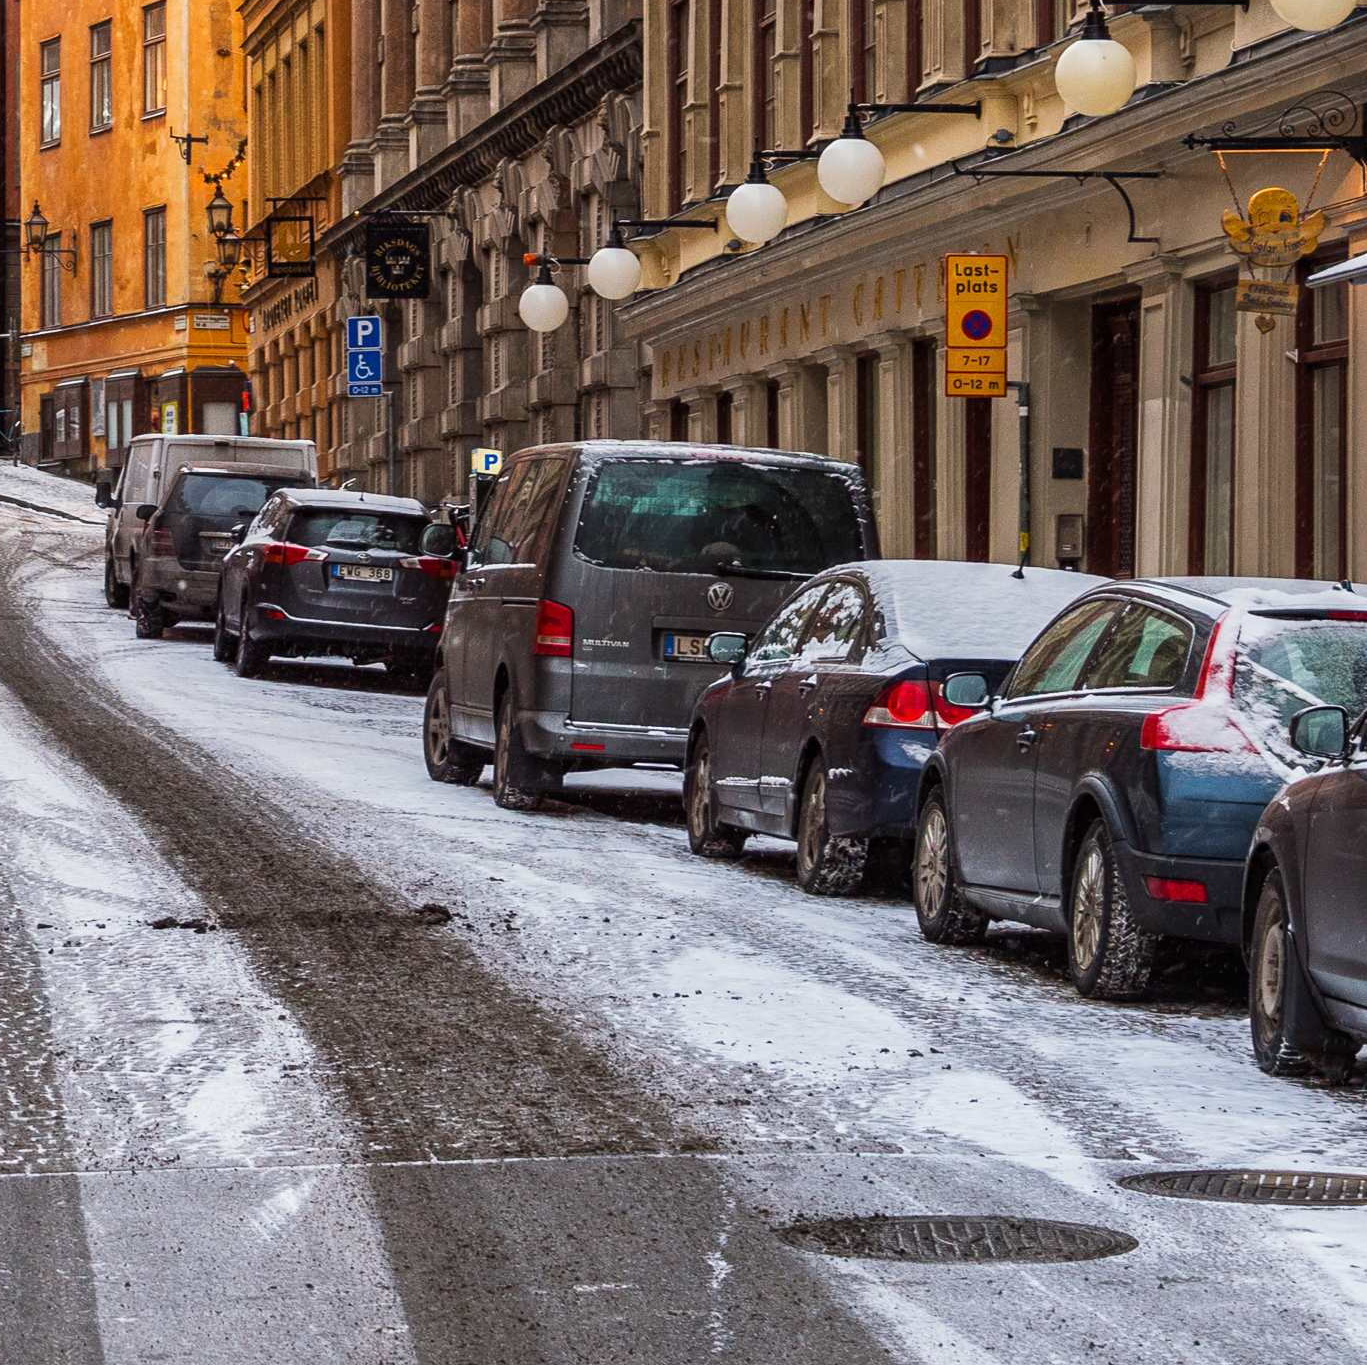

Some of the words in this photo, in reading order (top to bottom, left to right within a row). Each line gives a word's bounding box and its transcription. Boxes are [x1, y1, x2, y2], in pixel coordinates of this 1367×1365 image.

[374, 239, 422, 257] RIKSDAGS
[272, 265, 312, 274] apoteket
[955, 263, 999, 277] Last-
[371, 265, 424, 291] BIBLIOTEKET
[956, 280, 998, 295] plats
[661, 294, 832, 387] RESTAURANT
[852, 231, 1022, 326] CATTEN
[357, 321, 373, 345] P
[962, 355, 990, 366] 7-17
[352, 386, 369, 394] 0-12
[953, 379, 982, 389] 0-12
[988, 381, 999, 390] m
[484, 454, 498, 471] P
[339, 565, 361, 577] EWG
[368, 568, 390, 579] 368
[582, 638, 630, 648] MULTIVAN
